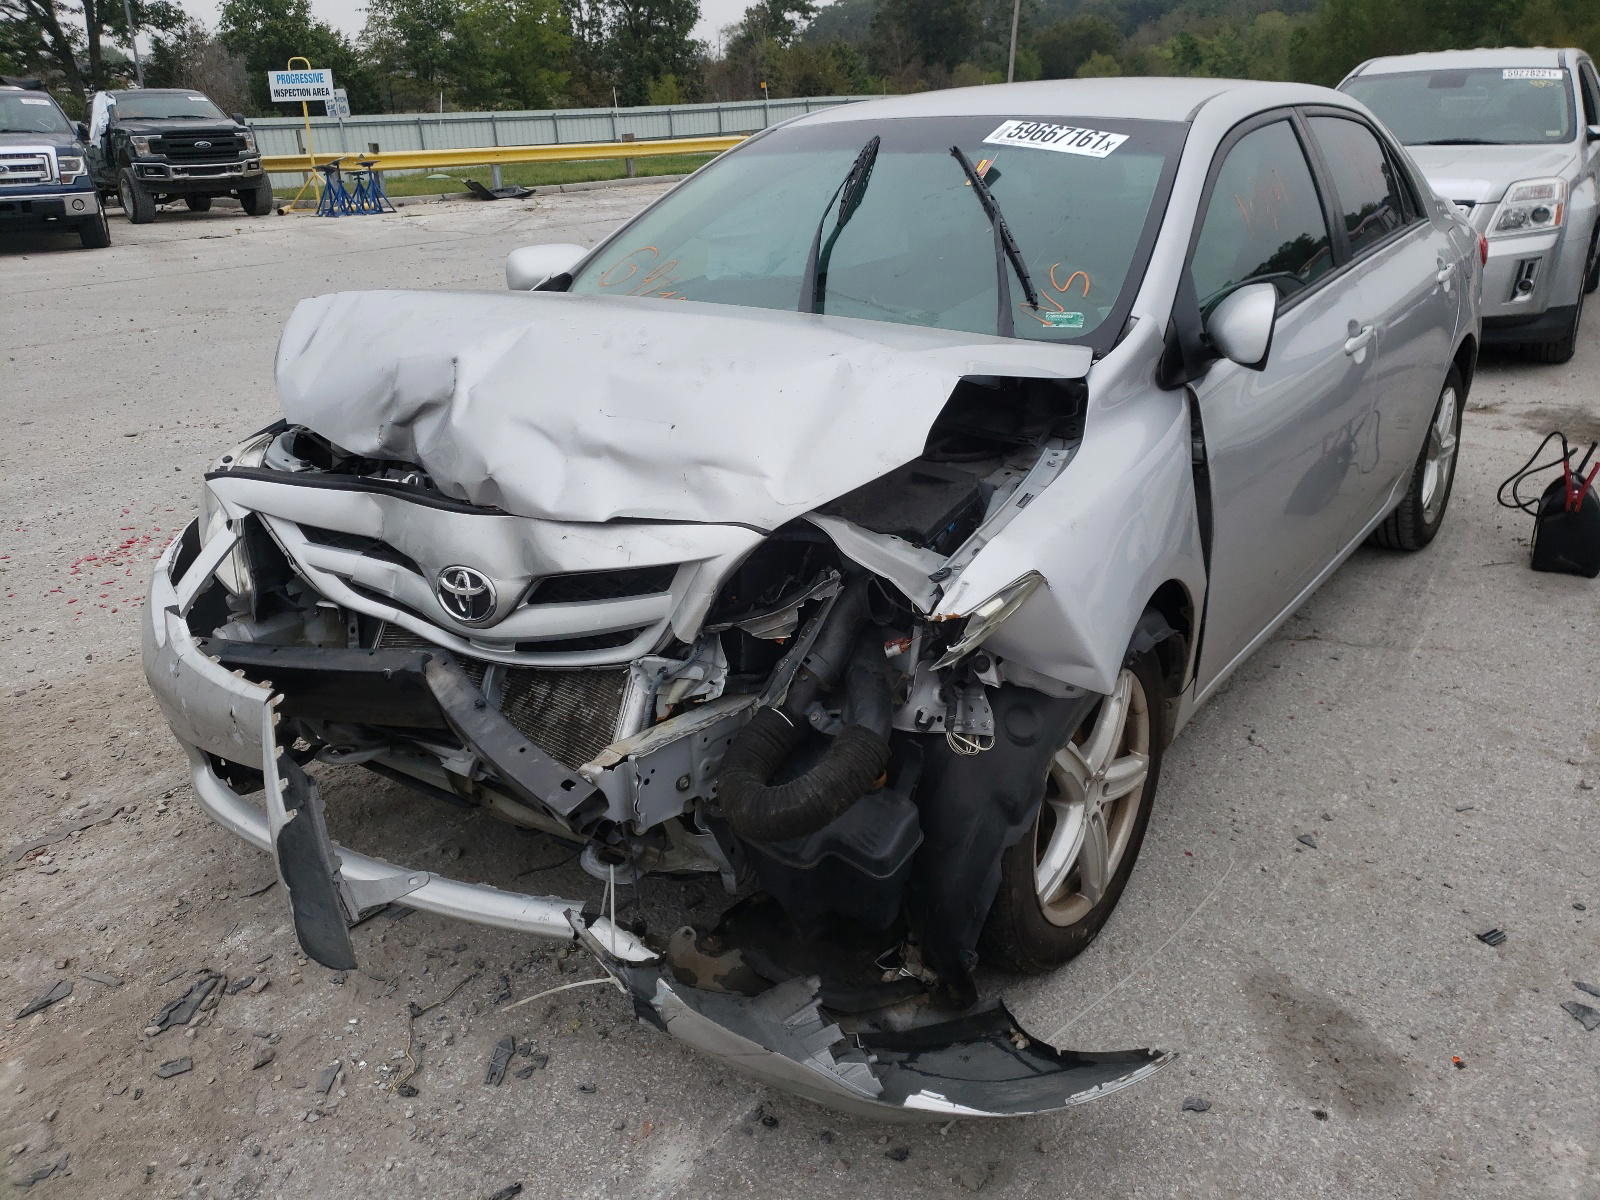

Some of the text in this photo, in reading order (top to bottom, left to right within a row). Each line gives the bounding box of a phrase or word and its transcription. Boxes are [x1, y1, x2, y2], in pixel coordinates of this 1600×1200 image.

[276, 72, 325, 85] PROGRESSIVE
[273, 87, 331, 98] INSPECTION AREA
